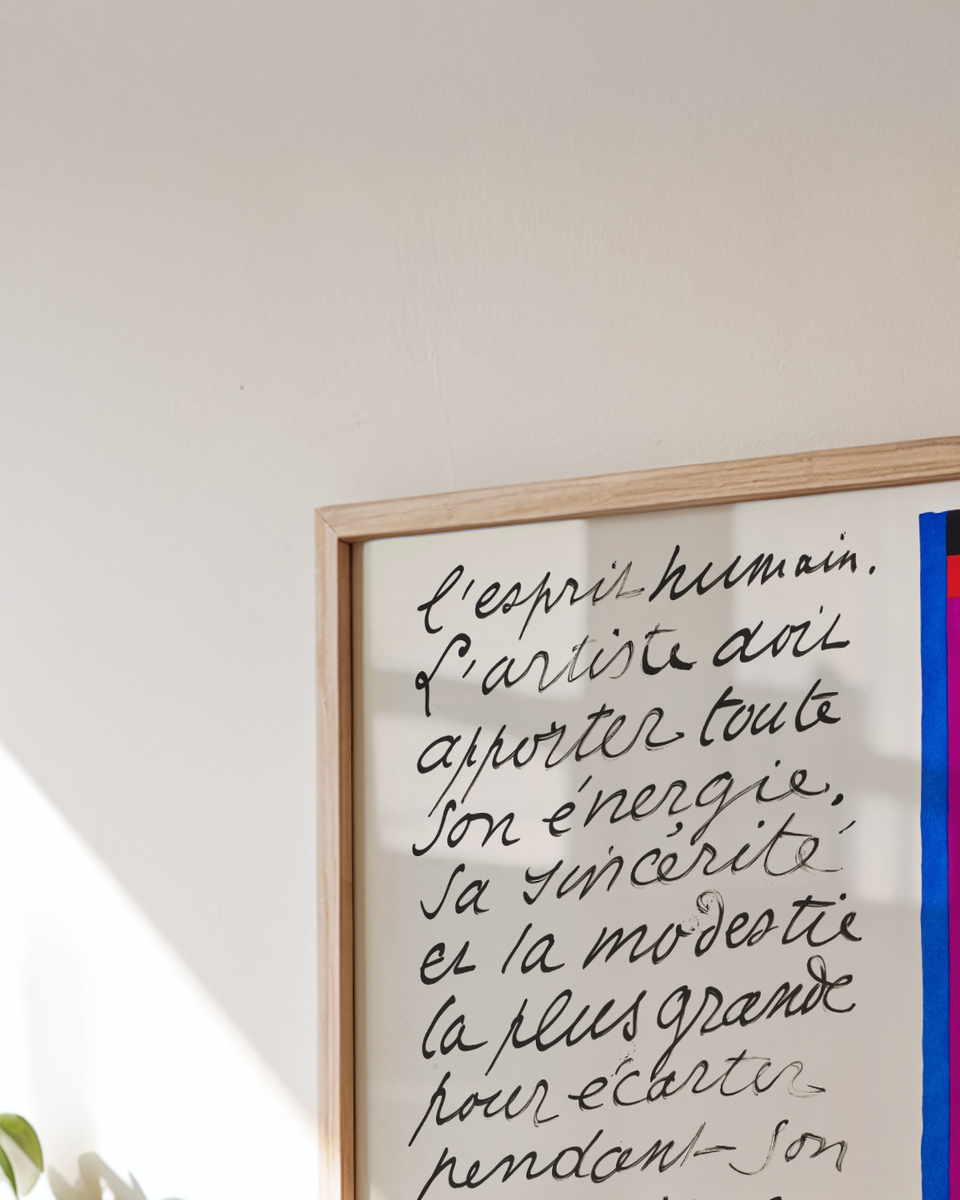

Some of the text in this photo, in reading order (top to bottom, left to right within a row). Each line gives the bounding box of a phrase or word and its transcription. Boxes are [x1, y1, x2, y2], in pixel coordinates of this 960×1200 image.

[649, 532, 877, 601] humain.
[415, 679, 842, 817] apporter toute
[501, 923, 565, 975] la
[421, 954, 857, 1082] la plus grande
[408, 1071, 559, 1146] pour
